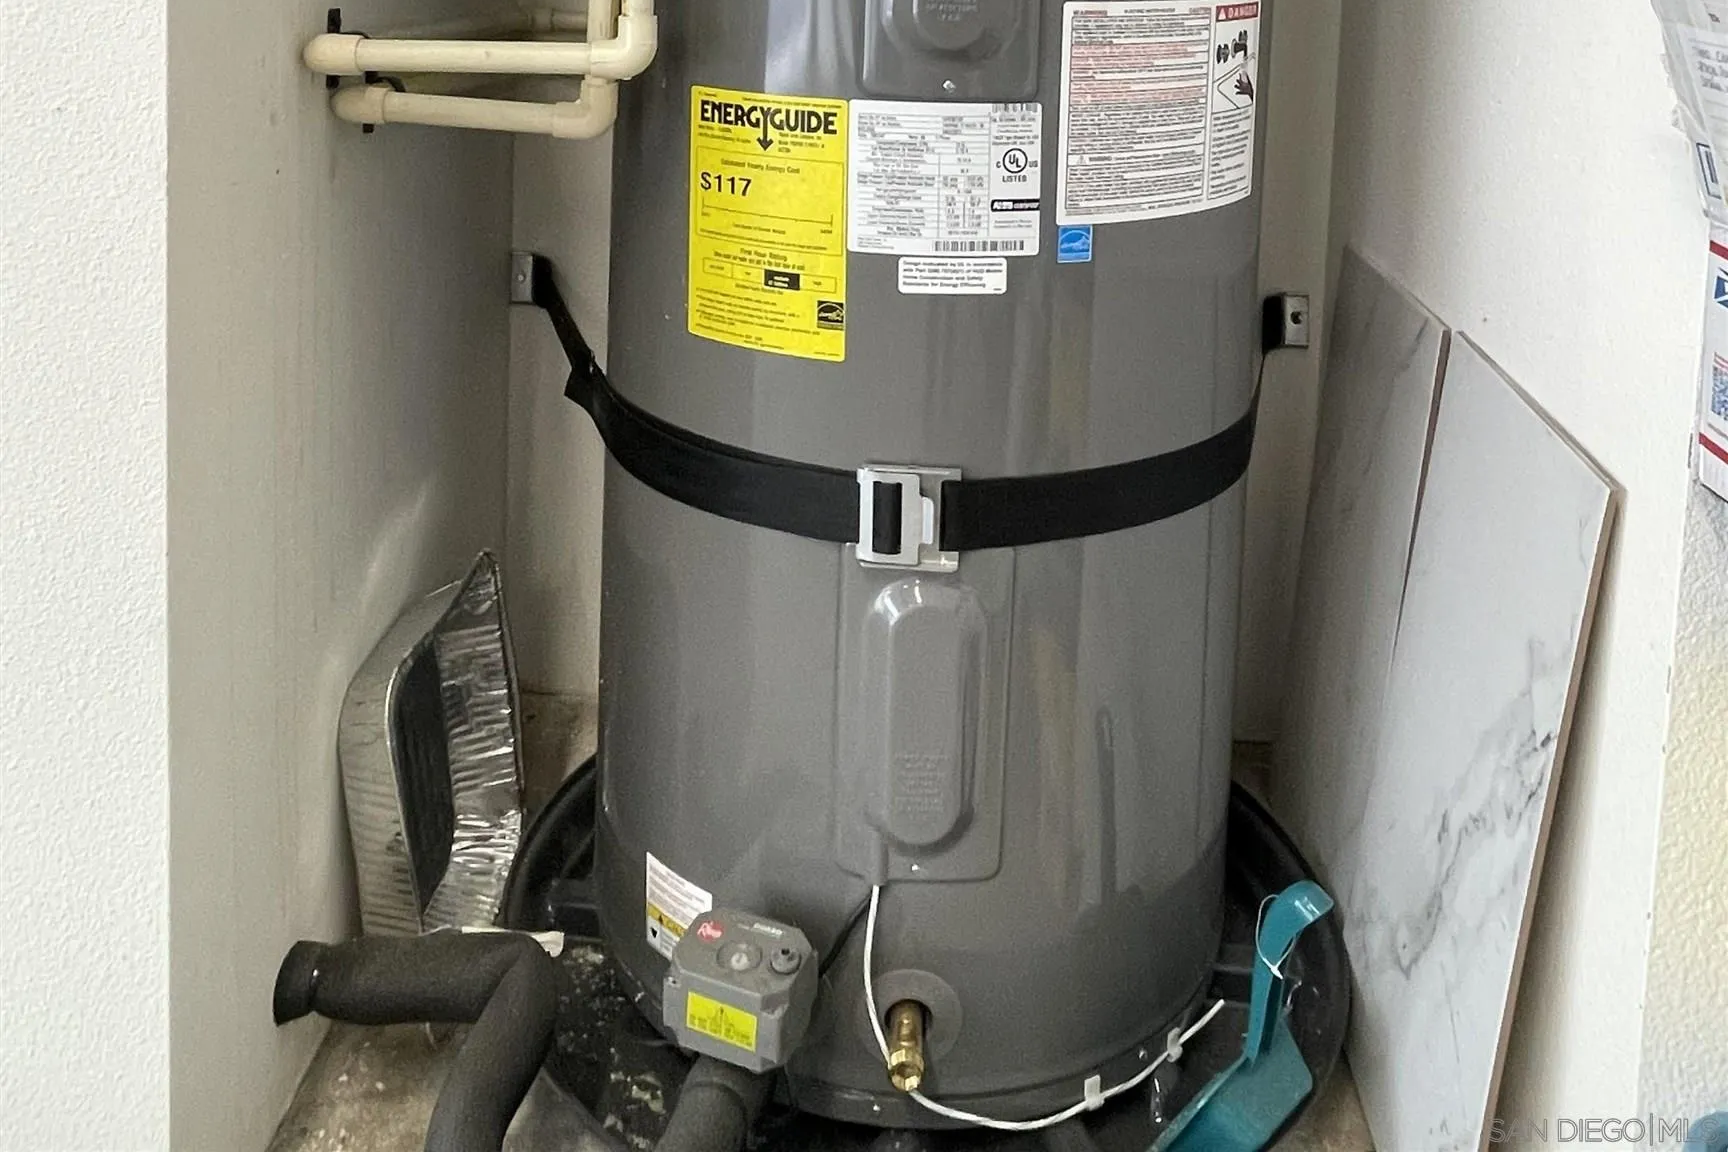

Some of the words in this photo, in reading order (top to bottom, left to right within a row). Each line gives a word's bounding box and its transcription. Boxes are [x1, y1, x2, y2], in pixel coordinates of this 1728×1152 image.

[700, 98, 838, 136] ENERGYGUIDE
[1008, 154, 1022, 169] UL
[700, 171, 753, 197] $117
[1002, 175, 1028, 183] LISTED
